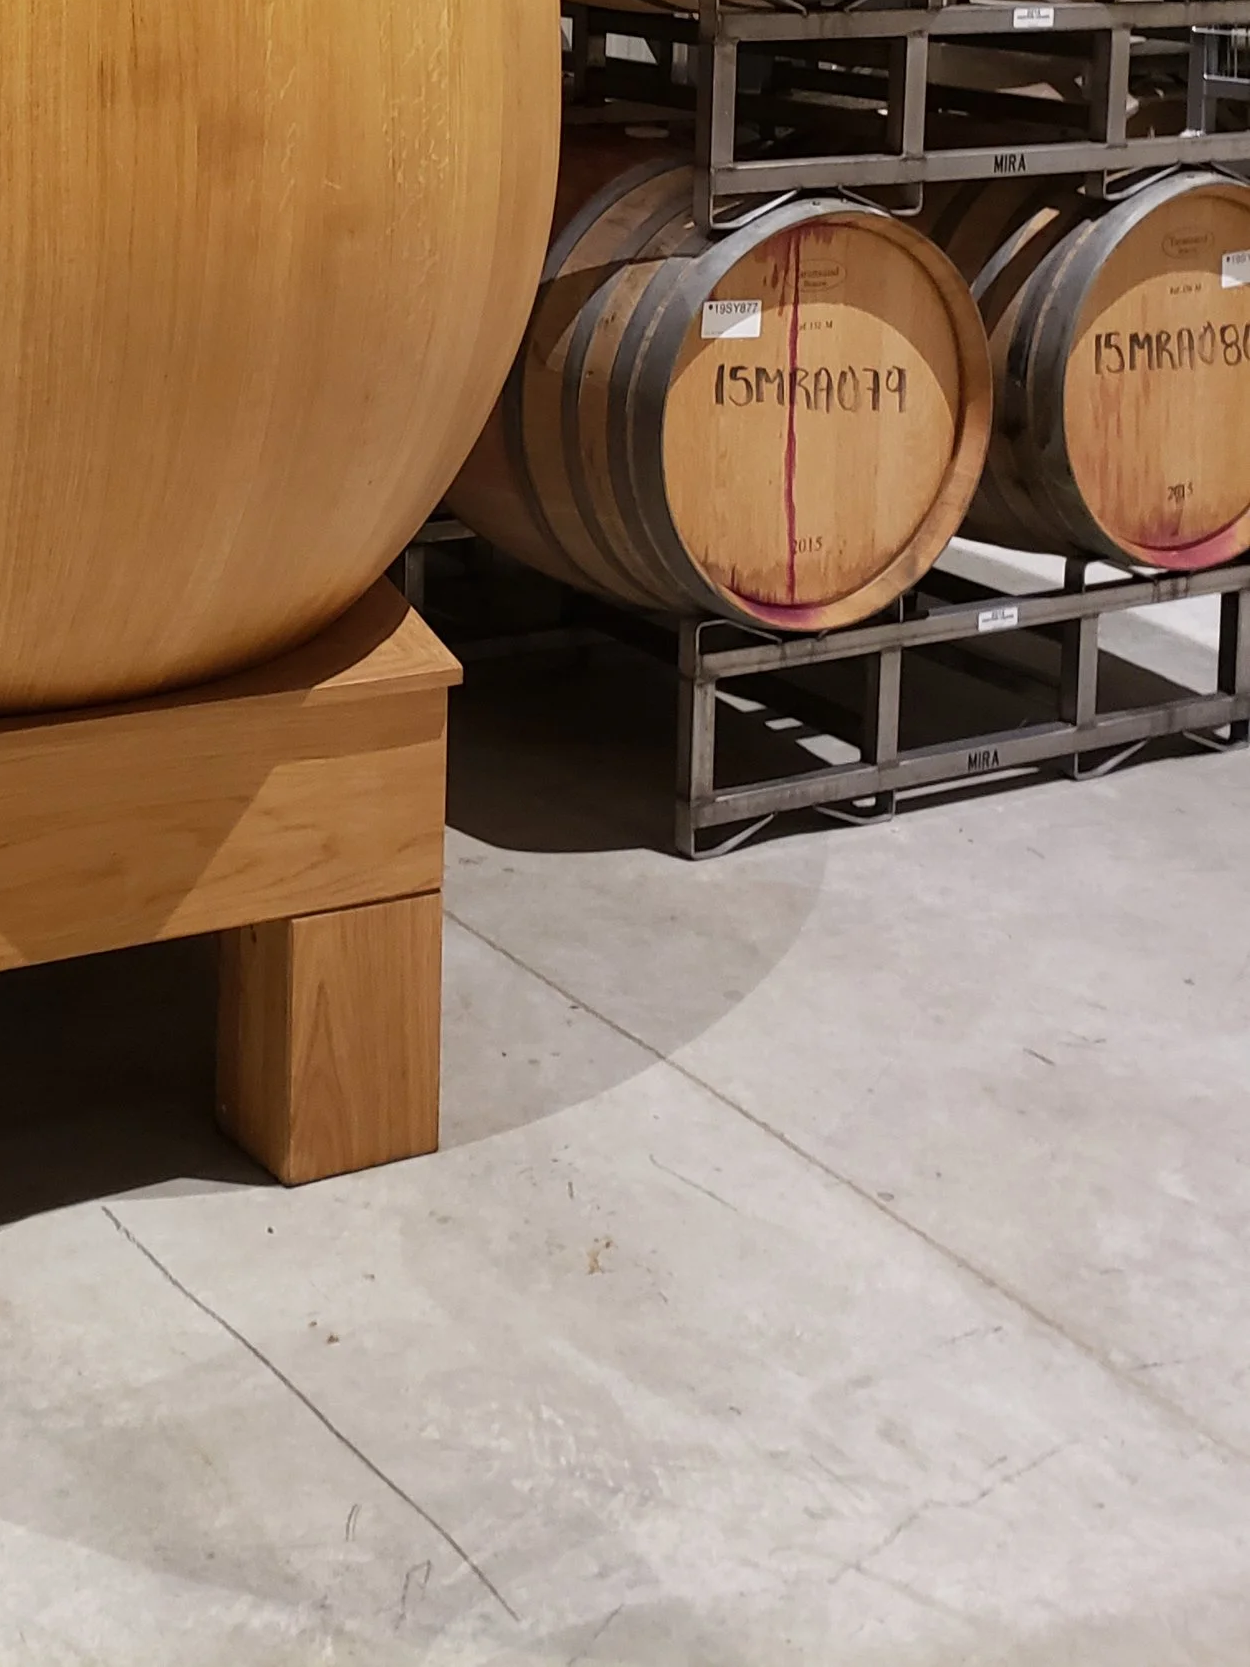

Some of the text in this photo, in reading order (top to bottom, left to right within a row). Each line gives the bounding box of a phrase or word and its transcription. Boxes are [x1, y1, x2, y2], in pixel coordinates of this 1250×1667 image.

[993, 152, 1026, 174] MIRA
[715, 301, 759, 315] 19SY877
[715, 363, 907, 414] 15MRA079
[792, 536, 823, 554] 2015
[967, 748, 1000, 772] MIRA
